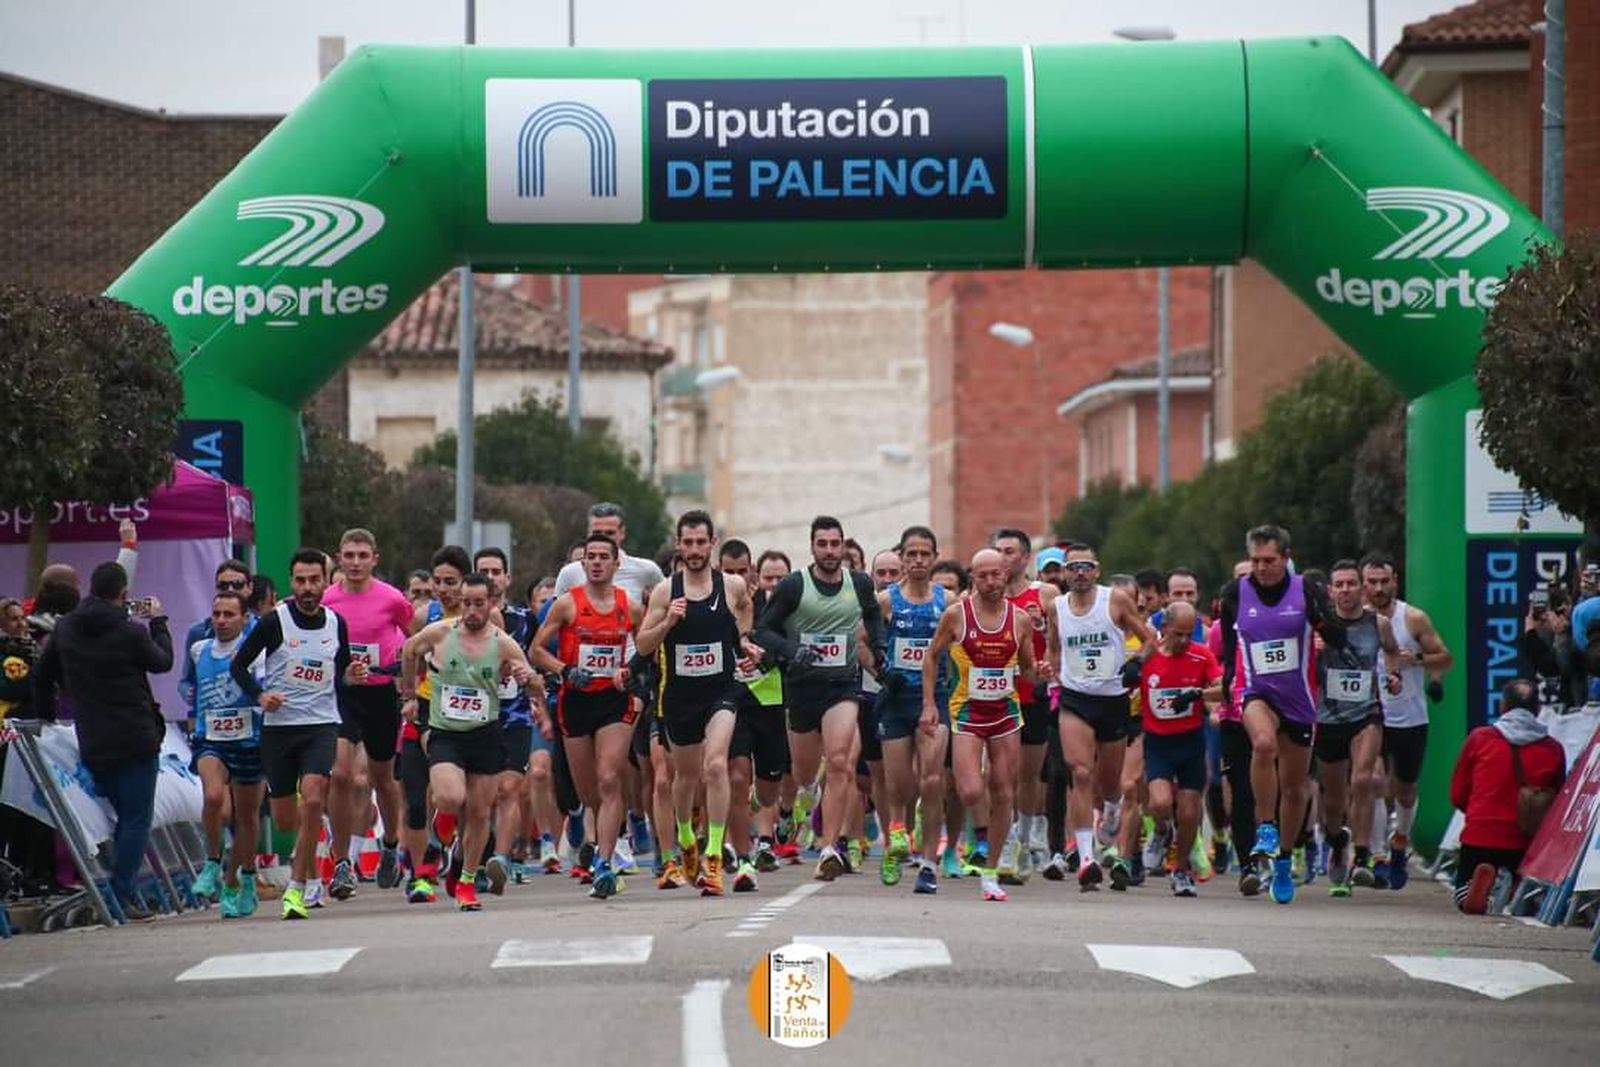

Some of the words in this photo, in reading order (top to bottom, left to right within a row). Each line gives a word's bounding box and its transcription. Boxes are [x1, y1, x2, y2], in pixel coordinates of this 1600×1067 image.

[665, 98, 930, 148] Diputación
[665, 159, 733, 198] DE
[749, 157, 995, 198] PALENCIA
[172, 276, 389, 325] deportes
[1486, 552, 1518, 606] DE
[809, 644, 840, 657] 40
[902, 648, 925, 661] 20
[1265, 649, 1286, 664] 58
[586, 654, 615, 668] 201
[684, 653, 716, 667] 230
[1086, 658, 1096, 671] 3
[293, 666, 324, 682] 208
[976, 678, 1007, 690] 239
[1341, 680, 1361, 692] 10
[449, 695, 483, 711] 275
[213, 717, 244, 732] 223
